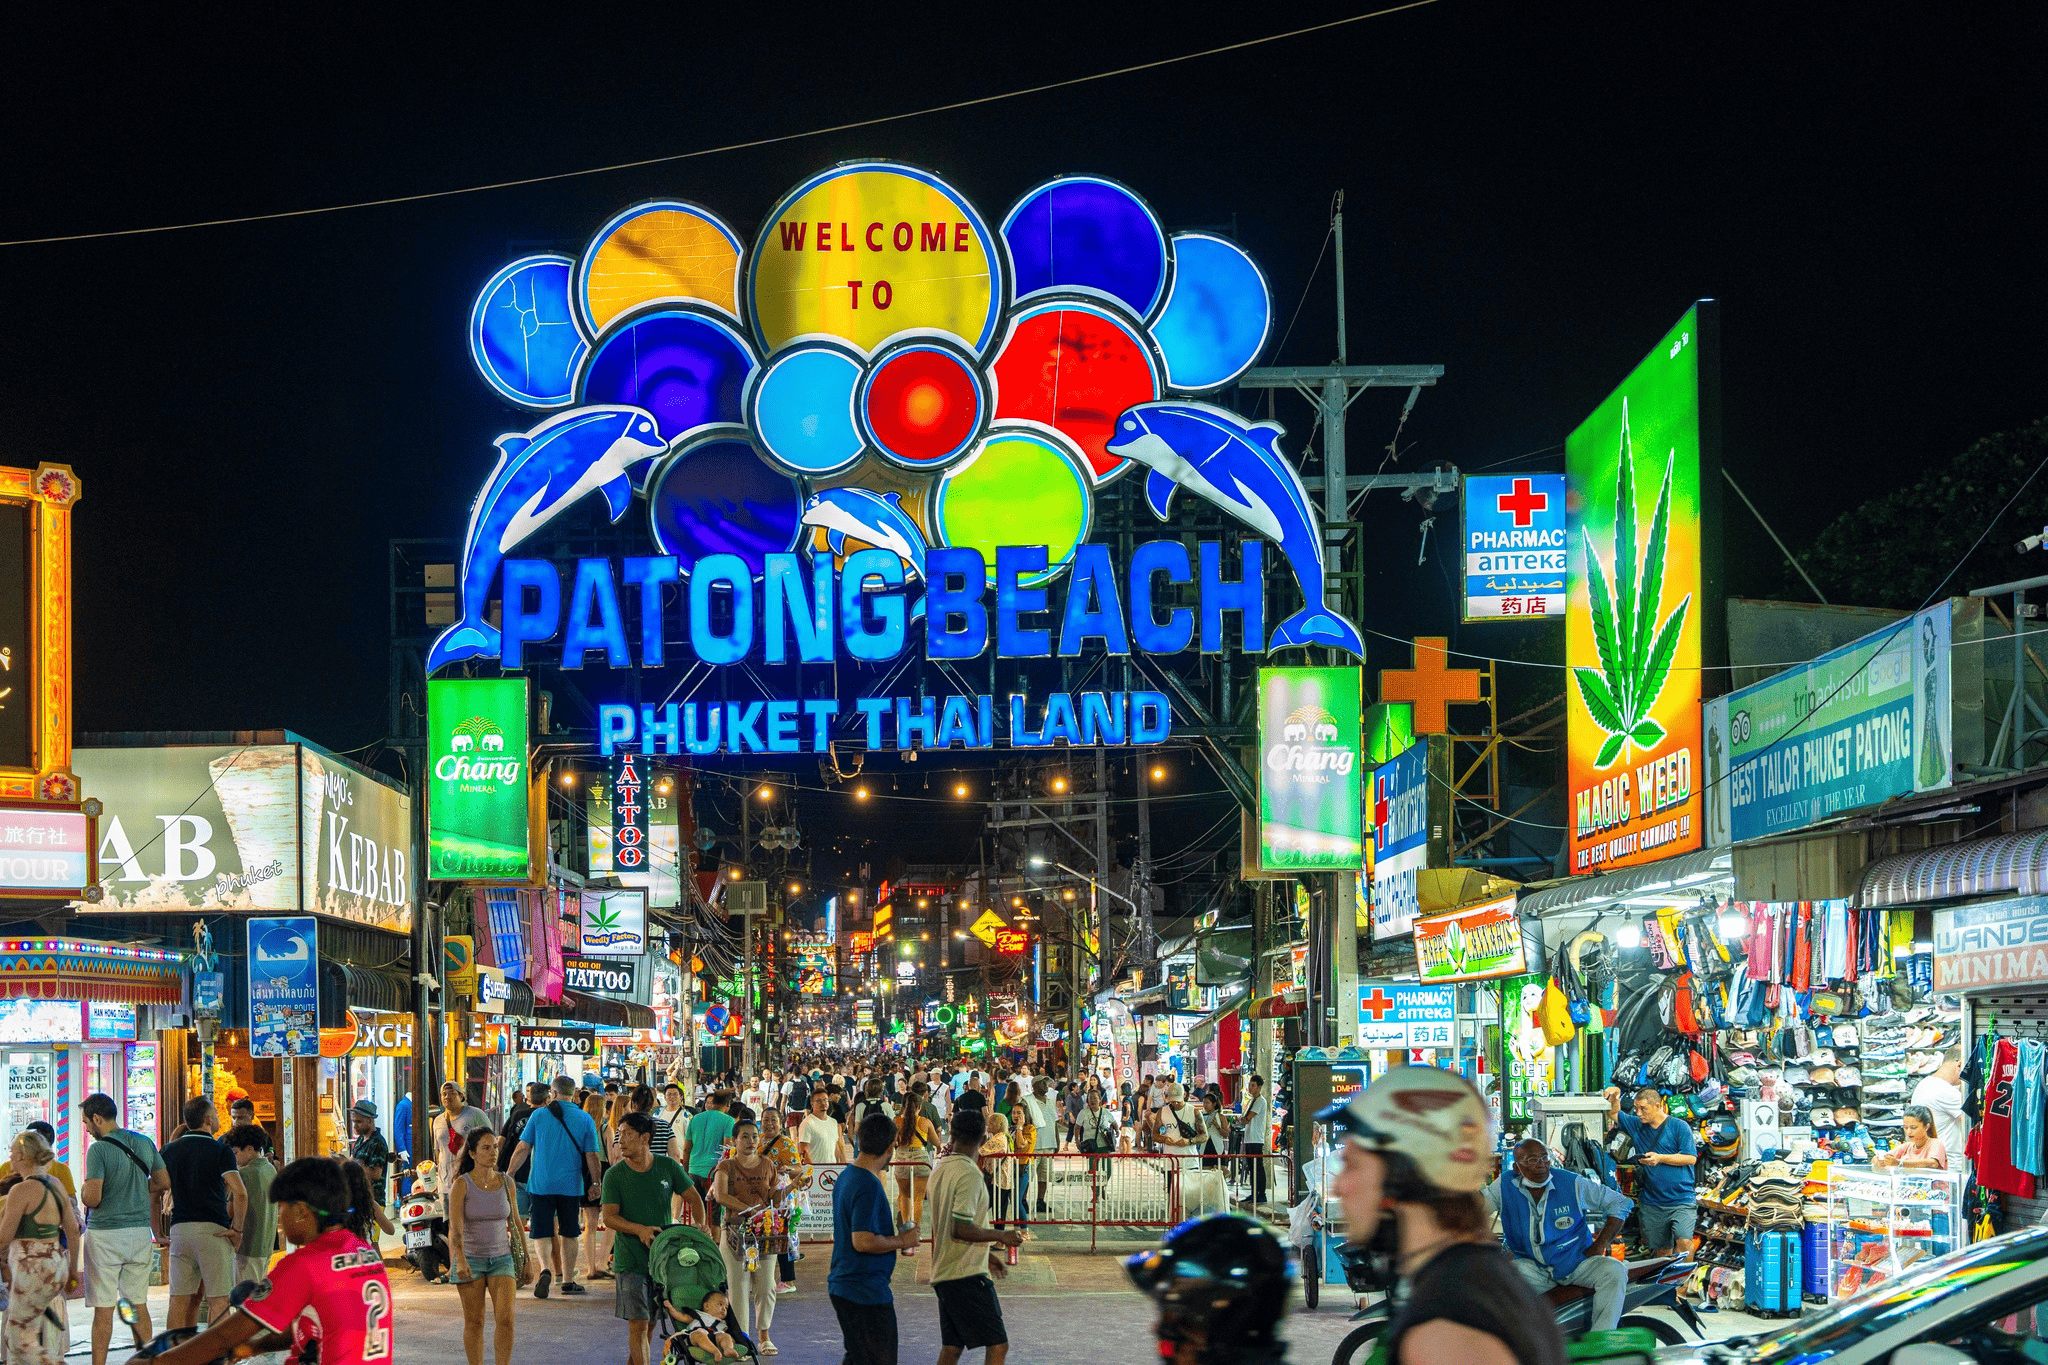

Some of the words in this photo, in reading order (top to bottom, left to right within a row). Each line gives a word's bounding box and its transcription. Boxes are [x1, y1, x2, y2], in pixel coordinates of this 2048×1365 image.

[779, 221, 970, 252] WELCOME
[847, 280, 894, 310] TO
[1471, 529, 1566, 550] PHARMAC
[1478, 554, 1566, 571] аптека
[500, 550, 909, 671] PATONG
[925, 540, 1264, 659] BEACH
[1501, 596, 1546, 614] 药店
[1793, 668, 1867, 722] tripadvisor
[599, 698, 839, 756] PHUKET
[1267, 744, 1355, 776] Chang
[1731, 759, 1757, 808] BEST
[1761, 745, 1799, 798] TAILOR
[1803, 727, 1852, 787] PHUKET
[1855, 707, 1910, 772] PATONG
[435, 755, 521, 785] Chang
[1576, 773, 1630, 840] MAGIC
[1636, 747, 1690, 818] WEED
[1766, 799, 1808, 827] EXCELLENT
[1825, 791, 1841, 813] THE
[1843, 784, 1866, 807] YEAR
[2, 826, 68, 845] 旅行社
[1577, 848, 1590, 869] THE
[1591, 842, 1608, 865] BEST
[1609, 833, 1638, 861] QUALITY
[1640, 819, 1677, 851] CANNABIS
[0, 858, 69, 881] TOUR
[327, 811, 406, 907] KEBAB
[215, 860, 283, 901] phuket
[611, 933, 639, 943] Factory
[1422, 925, 1451, 968] HAPPY
[1464, 920, 1514, 962] CANNABIS
[1937, 918, 2048, 954] WANDE
[566, 967, 631, 990] TATTOO
[1940, 949, 2048, 986] MINIMA
[252, 983, 316, 1000] เส้นทางหลบภัย
[1396, 991, 1453, 1006] PHARMACY
[94, 1008, 104, 1016] HAN
[104, 1009, 117, 1018] HONG
[117, 1010, 129, 1018] TOUR
[294, 1004, 315, 1012] ROUTE
[1398, 1008, 1451, 1019] аптека
[520, 1036, 591, 1053] TATTOO
[1413, 1026, 1448, 1042] 药店
[9, 1075, 48, 1083] NTERNET
[26, 1066, 47, 1074] 5G
[1511, 1060, 1549, 1077] GET
[25, 1083, 48, 1091] CARD
[1511, 1080, 1556, 1097] HIG
[1554, 1205, 1570, 1215] TAXI
[361, 1279, 390, 1362] 2
